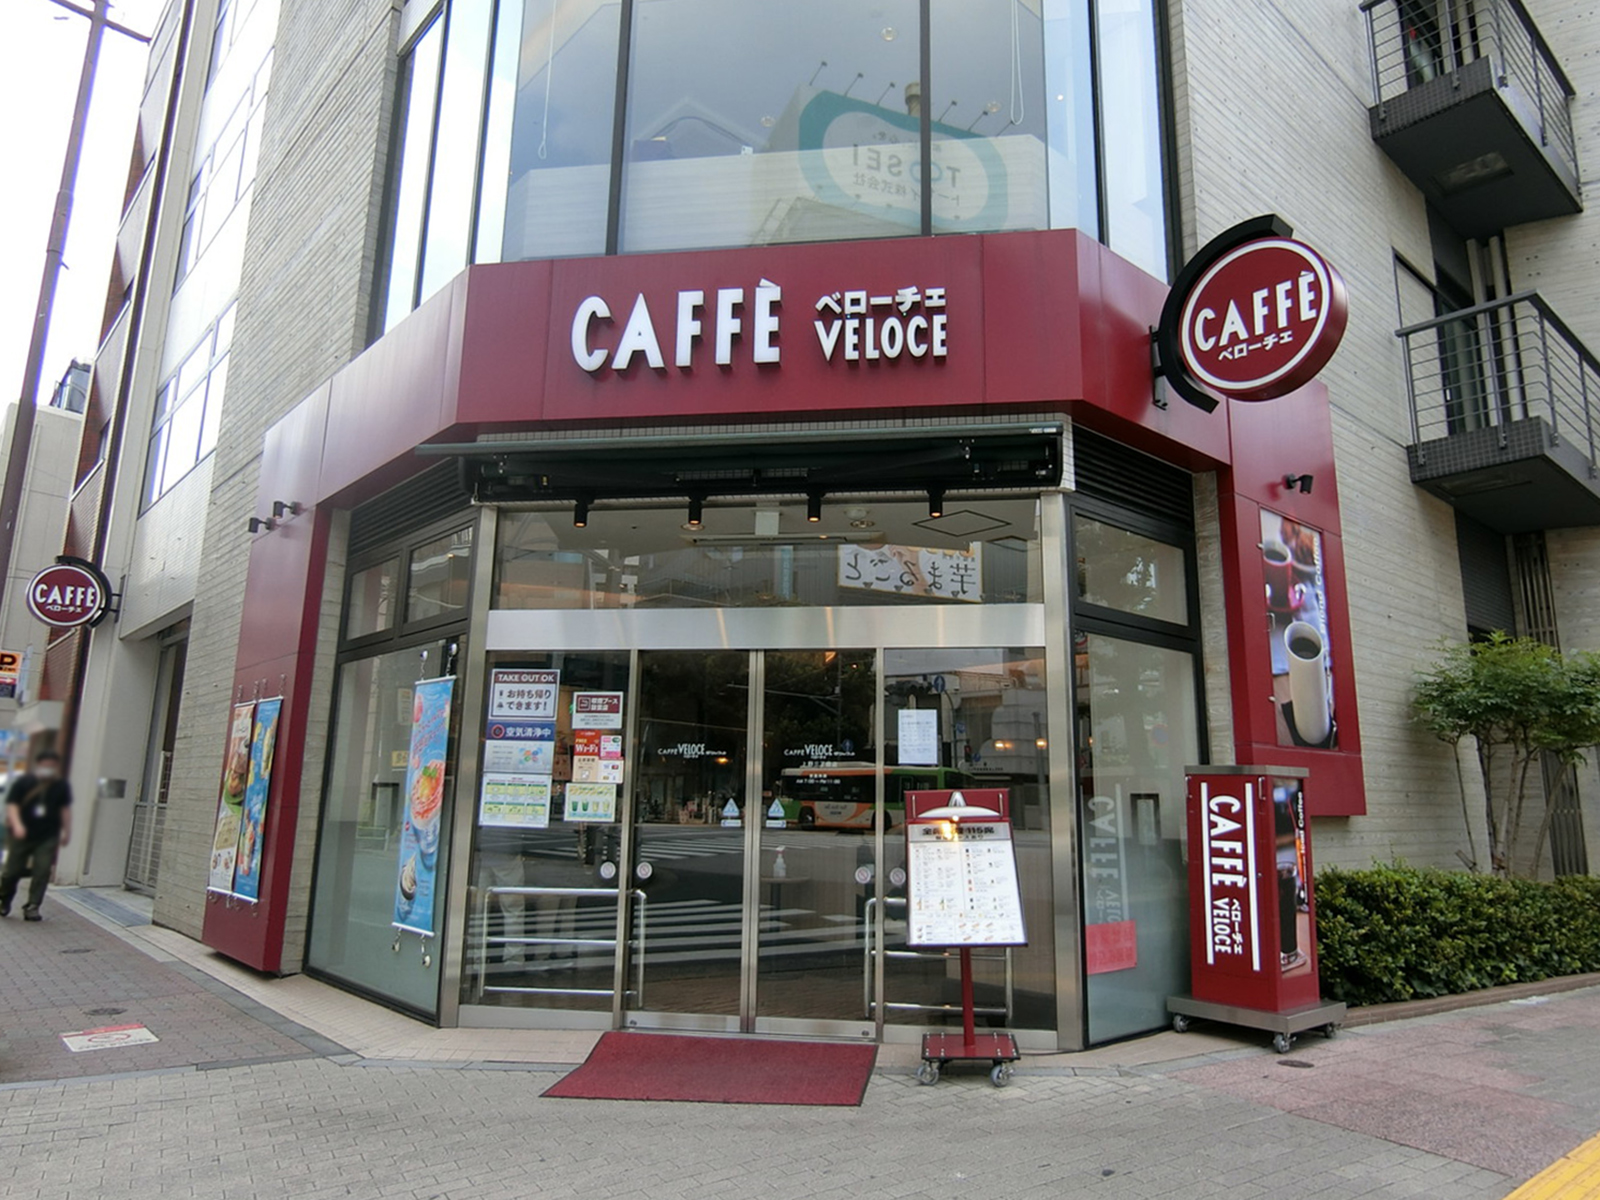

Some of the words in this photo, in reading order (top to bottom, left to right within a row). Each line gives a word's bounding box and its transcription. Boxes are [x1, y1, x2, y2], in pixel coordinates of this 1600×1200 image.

[571, 278, 781, 371] CAFFÈ
[1195, 271, 1317, 351] CAFFÈ
[814, 314, 947, 362] VELOCE
[35, 584, 95, 607] CAFFÈ
[498, 674, 520, 682] TAKE
[521, 673, 540, 683] OUT
[541, 673, 555, 682] OK
[677, 743, 705, 756] VELOCE
[804, 744, 833, 756] VELOCE
[1209, 795, 1247, 887] CAFFÈ
[1213, 898, 1232, 954] VELOCE
